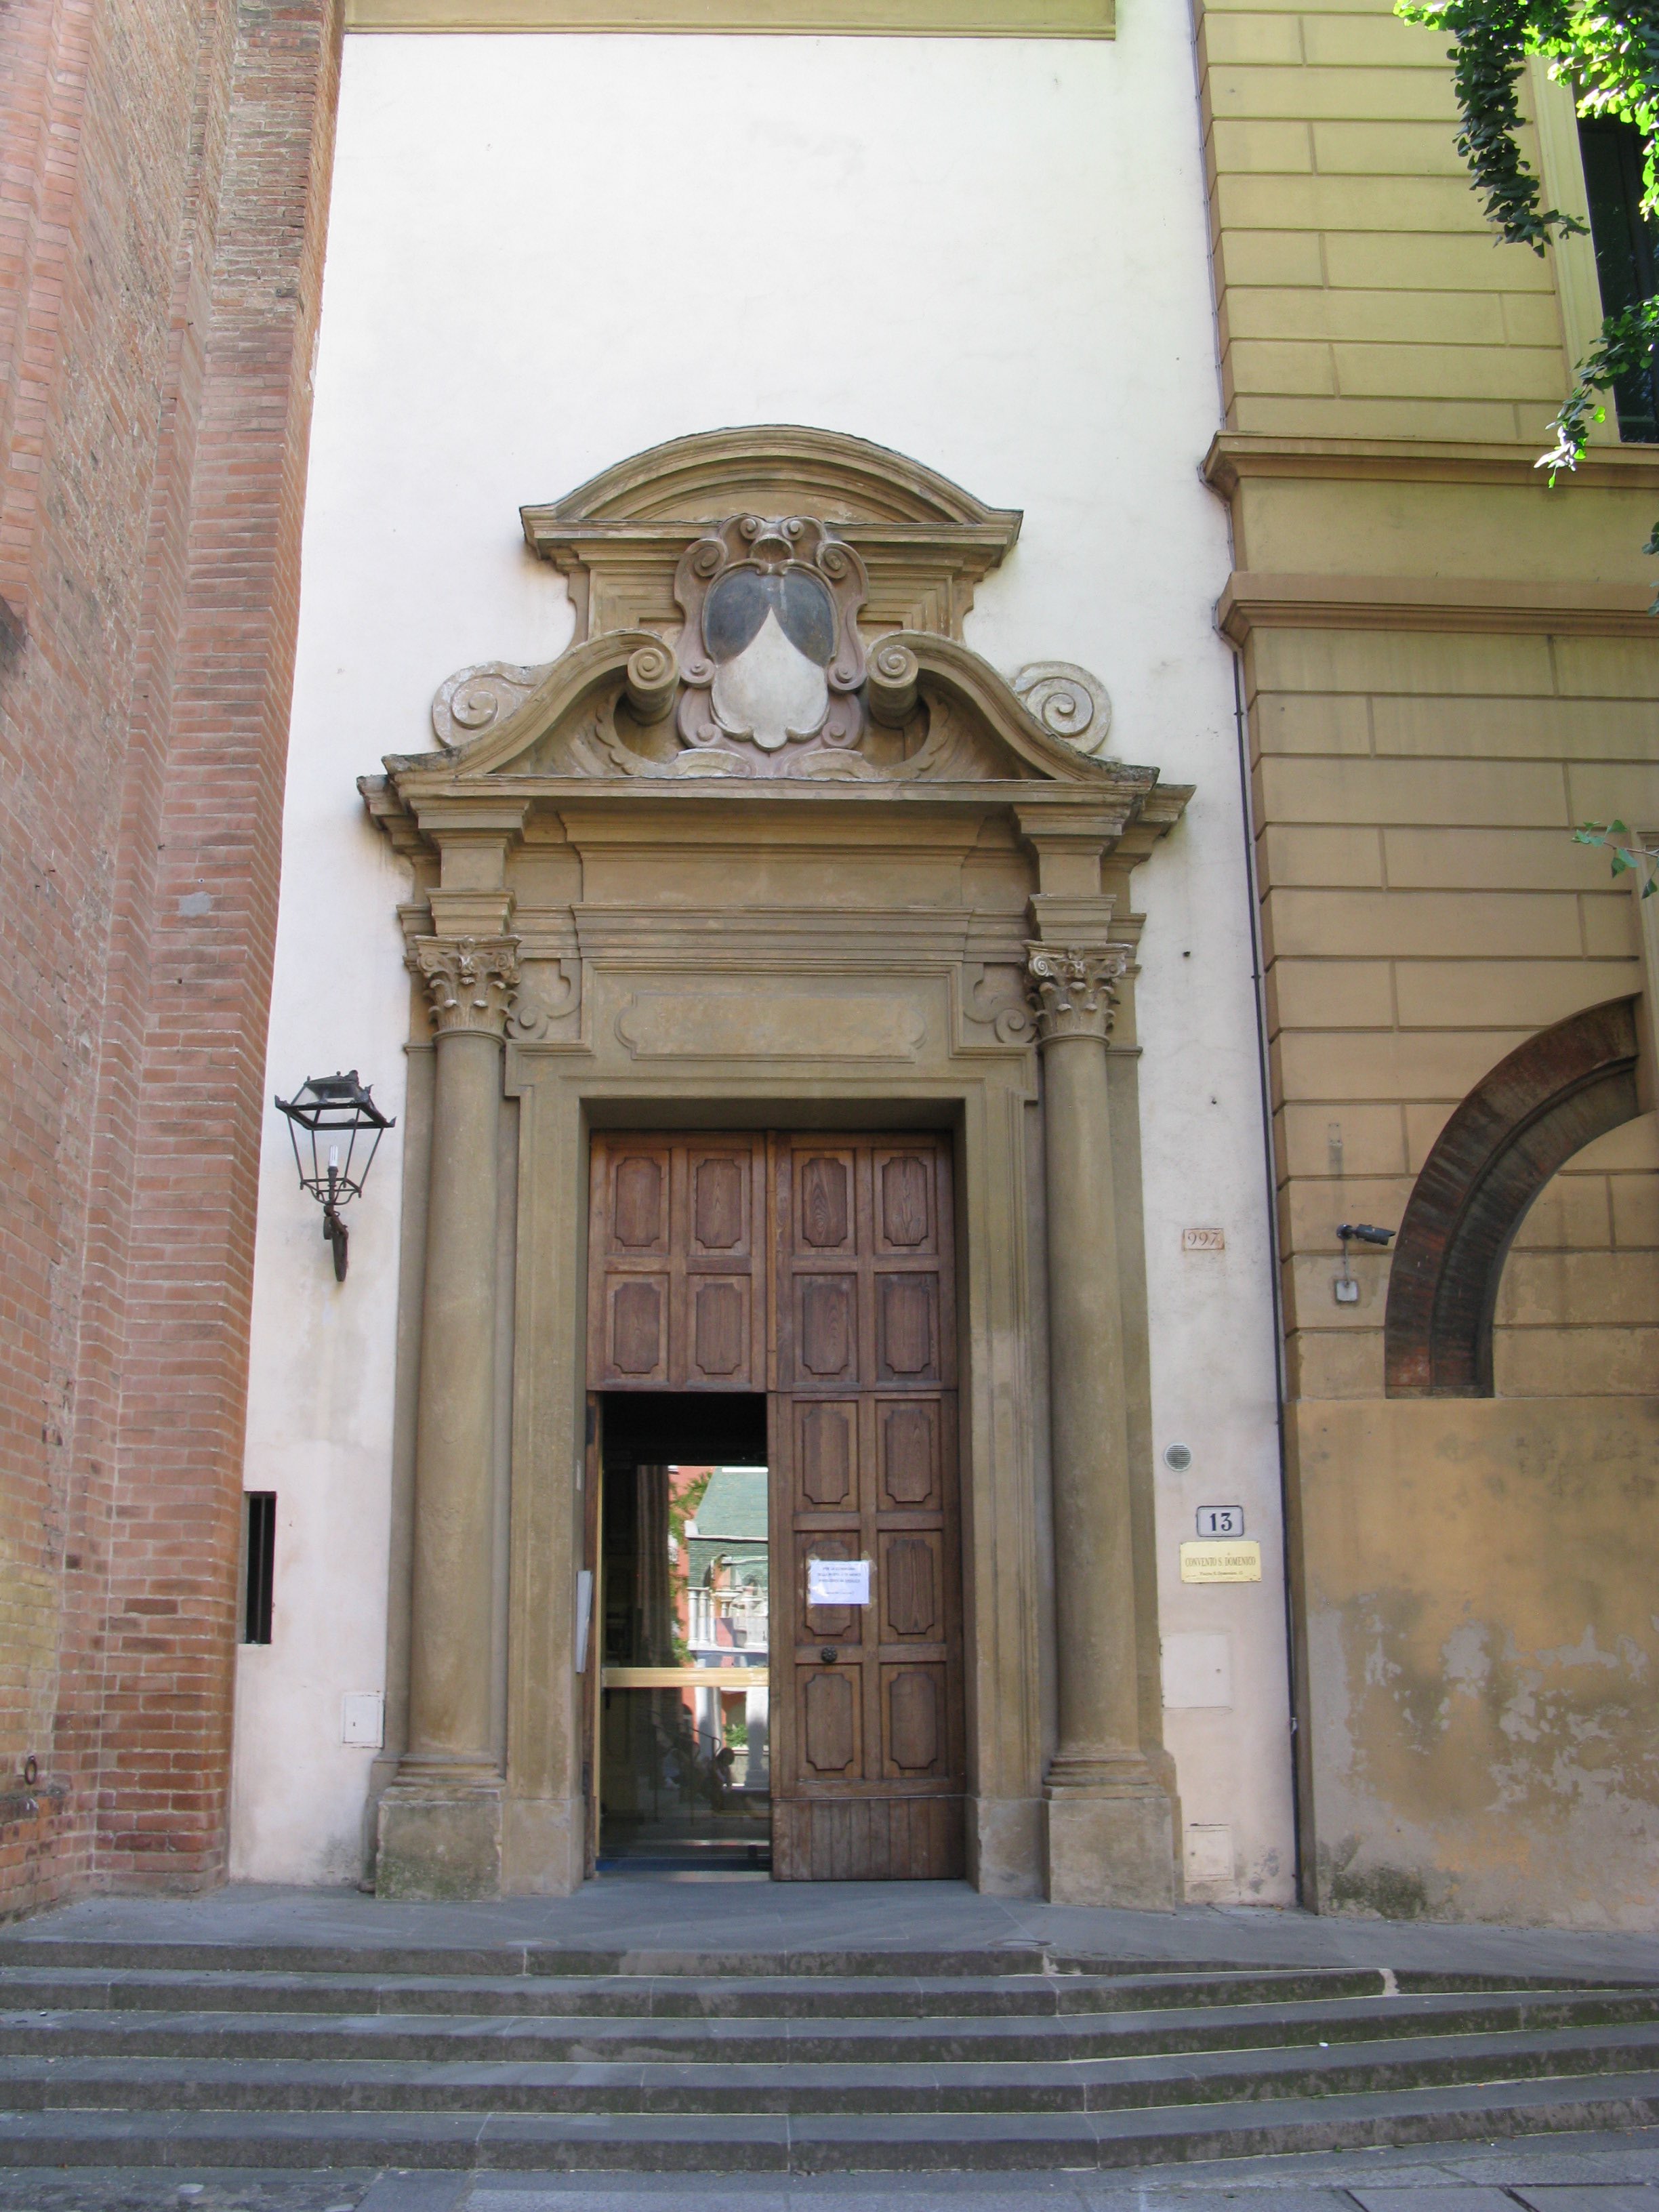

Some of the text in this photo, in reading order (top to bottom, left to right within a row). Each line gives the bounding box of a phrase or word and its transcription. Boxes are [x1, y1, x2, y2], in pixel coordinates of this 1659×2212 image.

[1187, 1231, 1220, 1246] 997
[1210, 1512, 1233, 1532] 13
[1185, 1557, 1217, 1567] CONVENTO
[1225, 1556, 1256, 1566] DOMENICO
